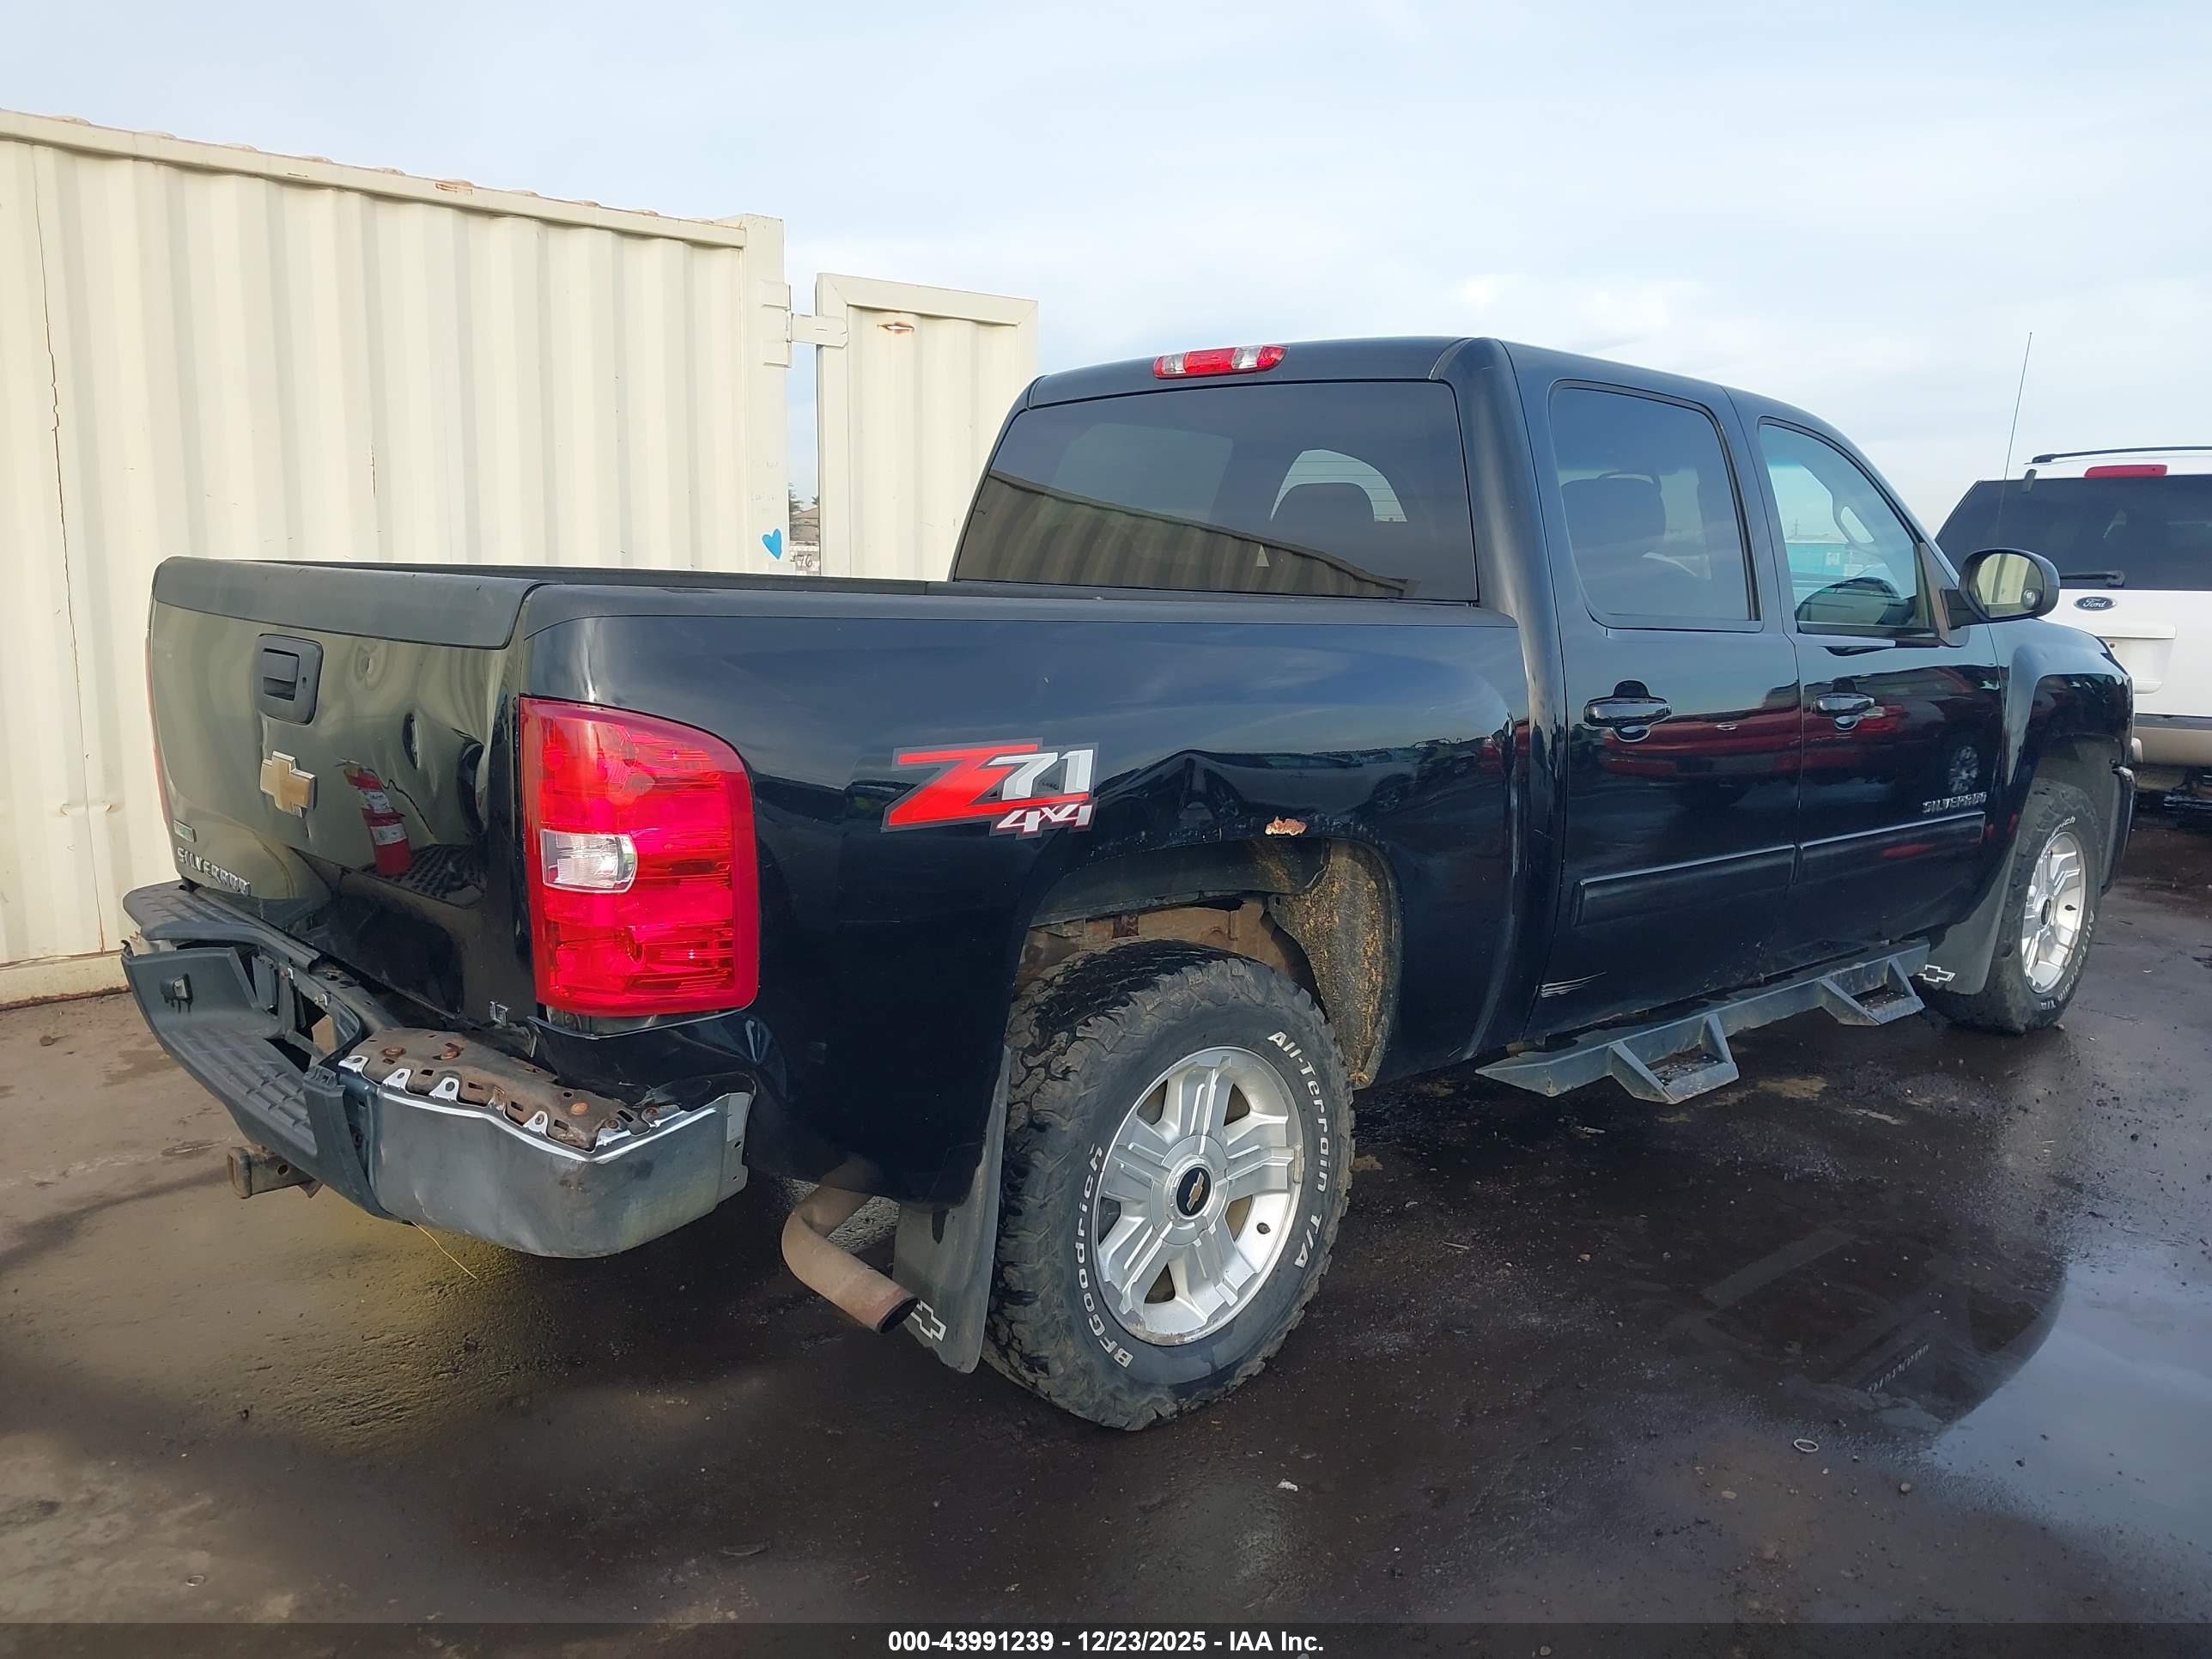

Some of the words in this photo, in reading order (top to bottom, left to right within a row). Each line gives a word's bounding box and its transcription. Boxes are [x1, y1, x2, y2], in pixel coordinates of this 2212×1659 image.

[2082, 598, 2107, 608] Ford
[888, 744, 1094, 826] Z71
[1923, 791, 1987, 813] SILVERADO
[177, 846, 252, 896] SILVERADO
[1267, 1030, 1331, 1193] All-Terrain
[1074, 1143, 1134, 1369] BFGoodrich
[1294, 1212, 1322, 1269] T/A
